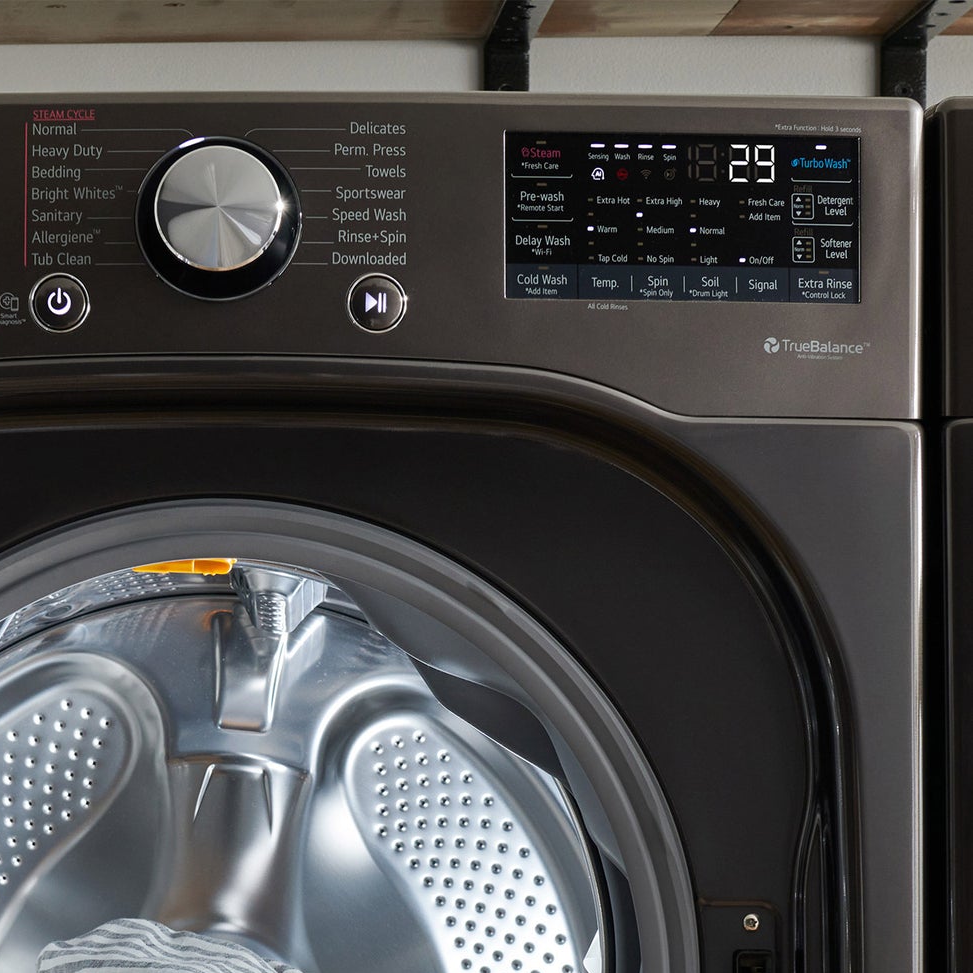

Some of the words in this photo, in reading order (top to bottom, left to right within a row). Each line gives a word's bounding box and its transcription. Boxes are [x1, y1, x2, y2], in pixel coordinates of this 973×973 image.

[33, 109, 64, 119] STEAM
[67, 109, 96, 119] CYCLE
[32, 122, 77, 135] Normal
[350, 121, 407, 135] Delicates
[32, 144, 69, 160] Heavy
[73, 144, 103, 159] Duty
[334, 143, 369, 156] Perm.
[373, 143, 406, 156] Press
[530, 148, 561, 159] Steam
[588, 153, 609, 162] Sensing
[614, 153, 630, 161] Wash
[638, 153, 654, 161] Rinse
[663, 154, 676, 162] Spin
[544, 162, 559, 170] Care
[729, 144, 775, 183] 29
[31, 165, 81, 181] Bedding
[365, 164, 406, 178] Towels
[31, 187, 69, 203] Bright
[335, 186, 407, 202] Sportswear
[520, 191, 565, 202] Pre-wash
[596, 196, 616, 204] Extra
[617, 196, 630, 205] Hot
[646, 197, 665, 205] Extra
[666, 197, 683, 207] High
[699, 198, 721, 207] Heavy
[748, 199, 766, 207] Fresh
[768, 199, 785, 207] Care
[817, 195, 854, 207] Detergent
[31, 208, 83, 224] Sanitary
[332, 208, 370, 224] Speed
[374, 208, 407, 221] Wash
[825, 206, 847, 216] Level
[748, 213, 763, 221] Add
[765, 213, 781, 221] Item
[597, 225, 617, 233] Warm
[646, 226, 675, 234] Medium
[699, 227, 725, 235] Normal
[338, 229, 407, 246] Rinse+Spin
[515, 235, 542, 247] Delay
[545, 235, 571, 246] Wash
[820, 238, 852, 248] Softener
[31, 252, 53, 266] Tub
[57, 252, 92, 266] Clean
[332, 251, 407, 265] Downloaded
[598, 254, 610, 263] Tap
[612, 254, 627, 262] Cold
[647, 255, 657, 263] No
[659, 255, 675, 264] Spin
[826, 249, 847, 259] Level
[699, 256, 718, 265] Light
[749, 256, 774, 265] On/Off
[517, 274, 539, 285] Cold
[542, 275, 568, 285] Wash
[592, 277, 619, 289] Temp.
[648, 275, 669, 287] Spin
[701, 276, 719, 287] Soil
[748, 279, 777, 290] Signal
[798, 278, 823, 289] Extra
[827, 279, 852, 289] Rinse
[659, 289, 674, 298] Only
[712, 290, 728, 298] Light
